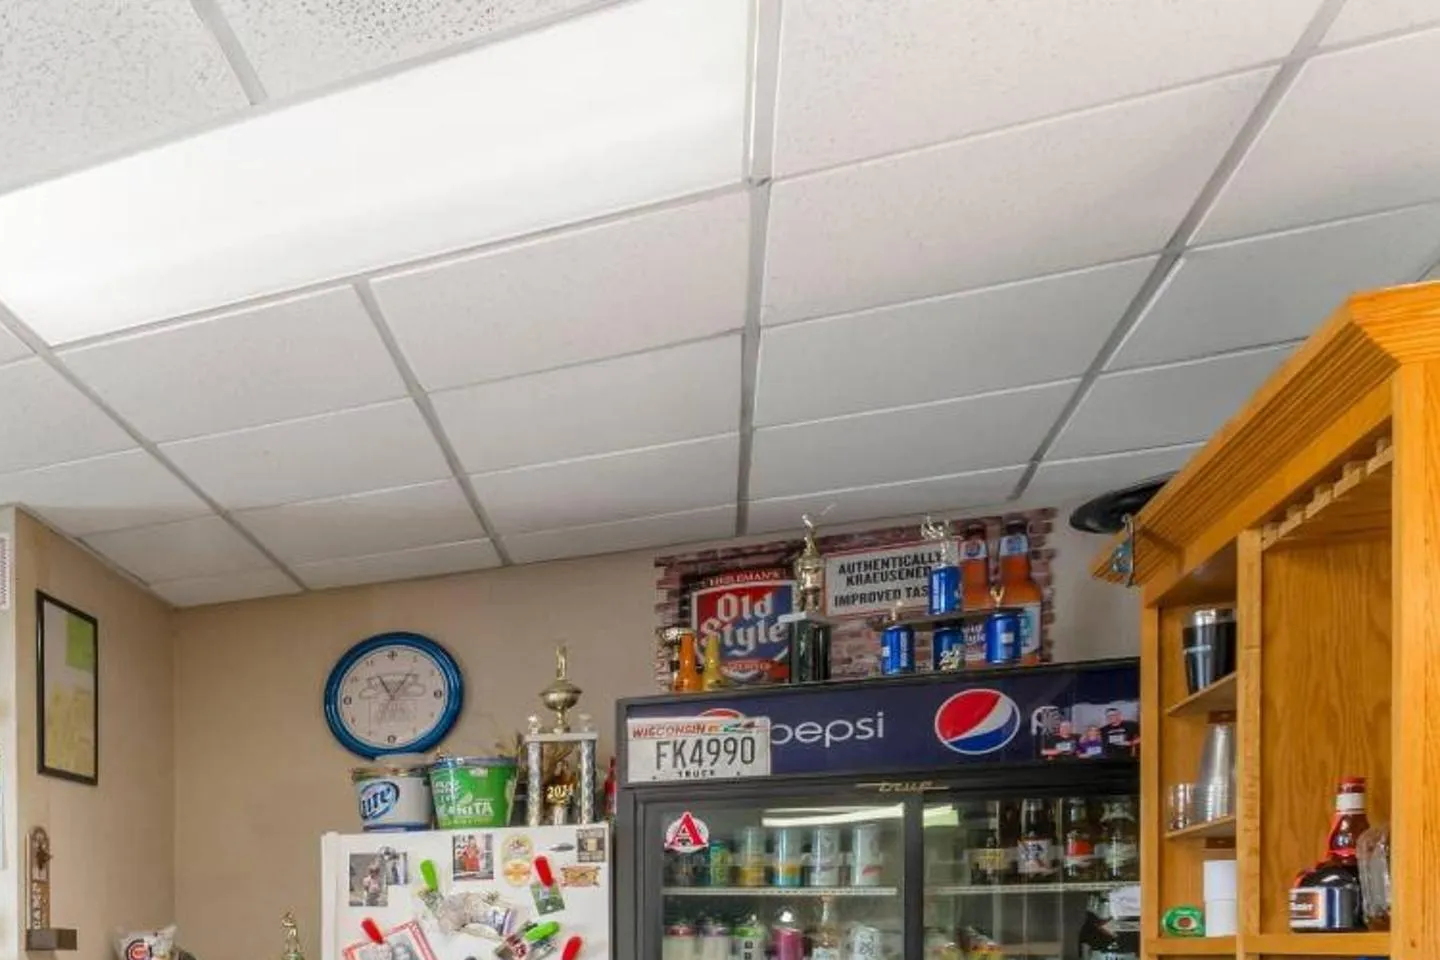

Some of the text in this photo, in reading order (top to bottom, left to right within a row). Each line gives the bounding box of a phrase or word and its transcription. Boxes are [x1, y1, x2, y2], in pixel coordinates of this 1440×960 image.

[838, 551, 942, 575] AUTHENTICALLY
[717, 591, 773, 621] Old
[834, 588, 902, 607] IMPROVED
[905, 584, 929, 599] TAS
[700, 616, 790, 656] Style
[633, 722, 707, 739] WISCONSIN
[771, 711, 885, 748] pepsi
[656, 736, 756, 770] FK4990
